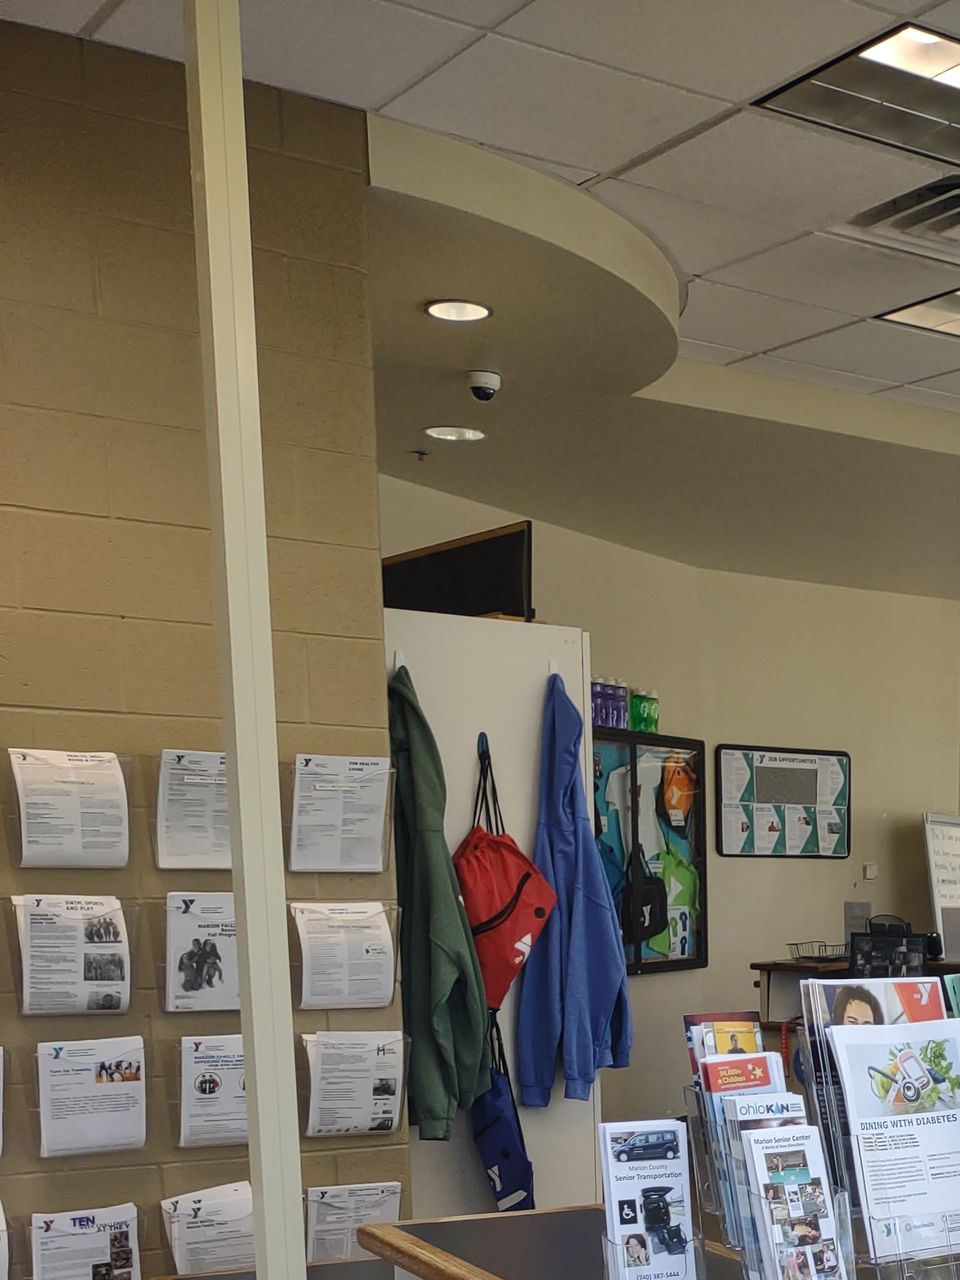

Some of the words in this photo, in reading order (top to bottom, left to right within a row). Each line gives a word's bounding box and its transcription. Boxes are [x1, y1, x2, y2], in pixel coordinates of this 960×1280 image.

[917, 984, 932, 1005] Y
[860, 1121, 888, 1130] DINING
[890, 1118, 913, 1128] WITH
[916, 1114, 957, 1126] DIABETES
[636, 1172, 682, 1180] Transportation
[70, 1216, 95, 1227] TEN
